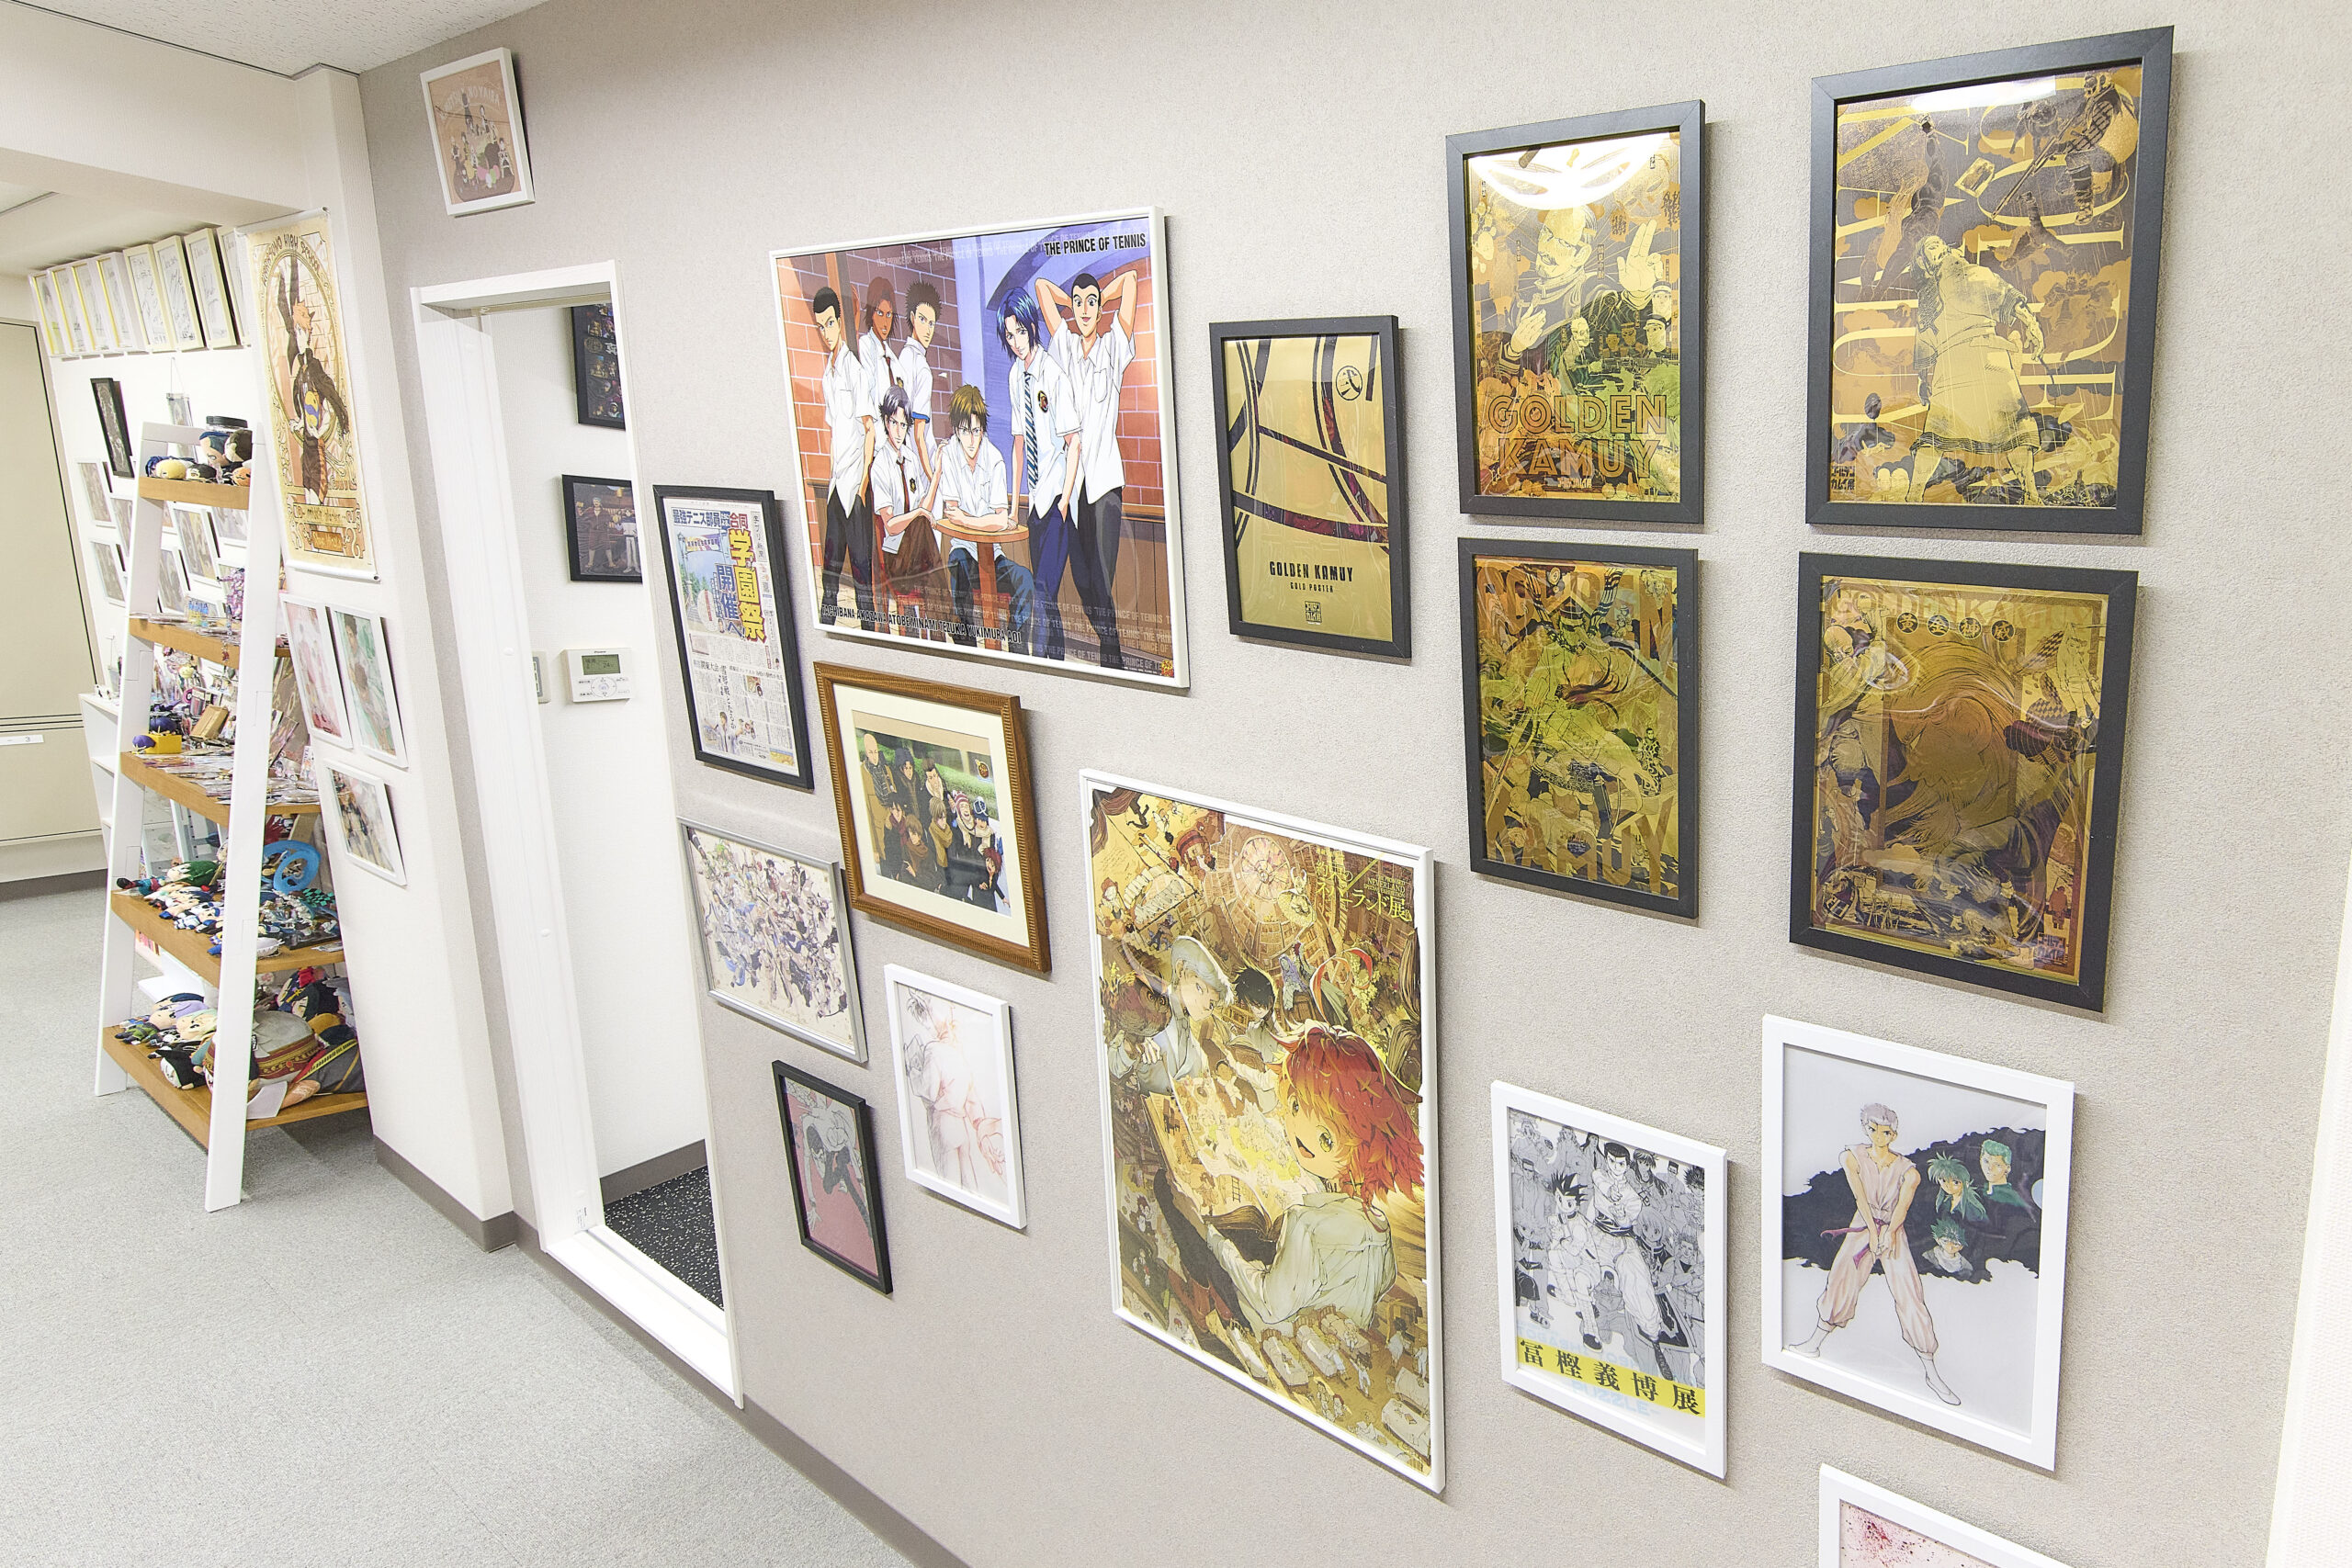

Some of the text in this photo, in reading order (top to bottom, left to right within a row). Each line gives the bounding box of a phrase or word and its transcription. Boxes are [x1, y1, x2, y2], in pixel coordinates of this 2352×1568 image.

[1044, 232, 1147, 256] THE PRINCE OF TENNIS
[1487, 394, 1668, 434] GOLDEN
[1498, 437, 1661, 479] KAMUY
[673, 509, 721, 528] 最強テニス部員
[729, 512, 749, 530] 合同
[1270, 561, 1353, 582] GOLDEN KAMUY
[728, 528, 768, 643] 学園祭
[1308, 583, 1334, 593] POSTER
[821, 604, 1022, 644] TACHIBANA AKAZAWA ATOBE MINAMI TEZUKA YUKIMURA AOI
[1367, 877, 1406, 894] NEVERLAND
